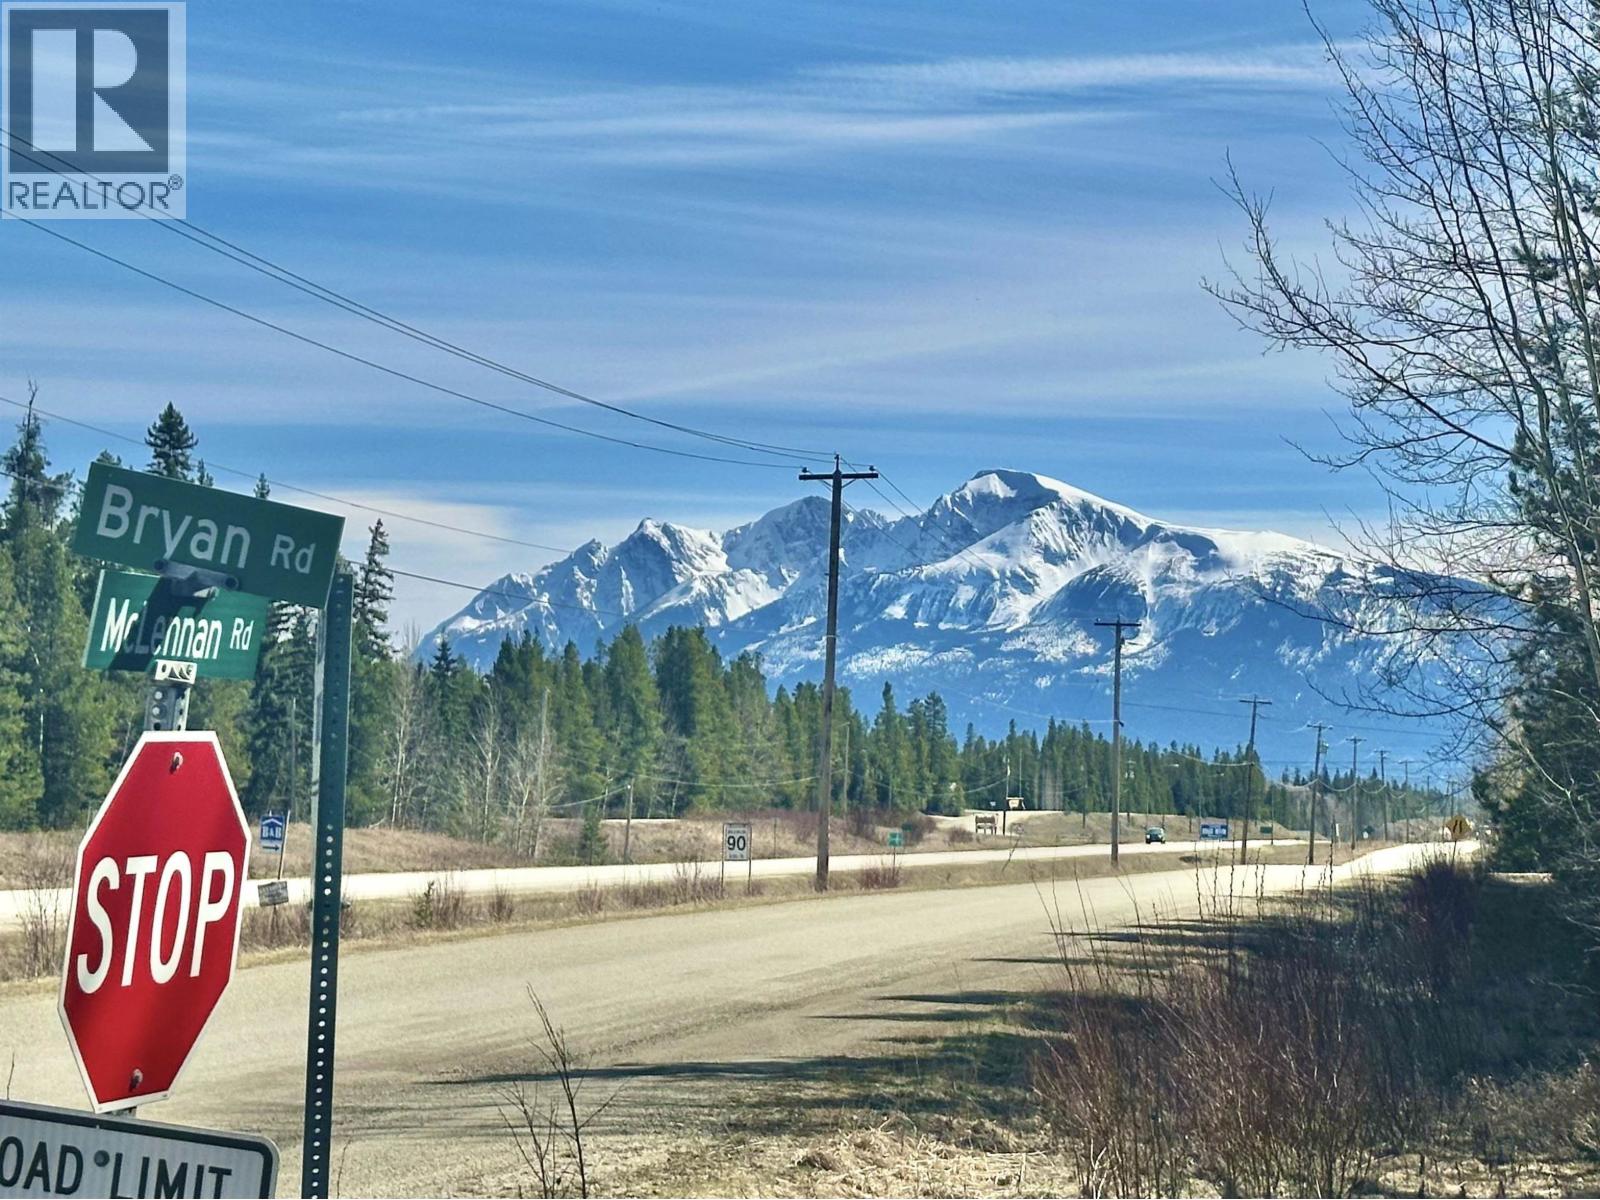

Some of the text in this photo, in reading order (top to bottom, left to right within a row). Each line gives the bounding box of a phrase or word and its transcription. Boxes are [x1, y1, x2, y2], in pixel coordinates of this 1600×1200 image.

[96, 483, 316, 575] Bryan Rd
[100, 597, 255, 660] McLennan Rd
[727, 835, 746, 851] 90
[76, 850, 235, 995] STOP
[110, 1152, 233, 1200] LIMIT
